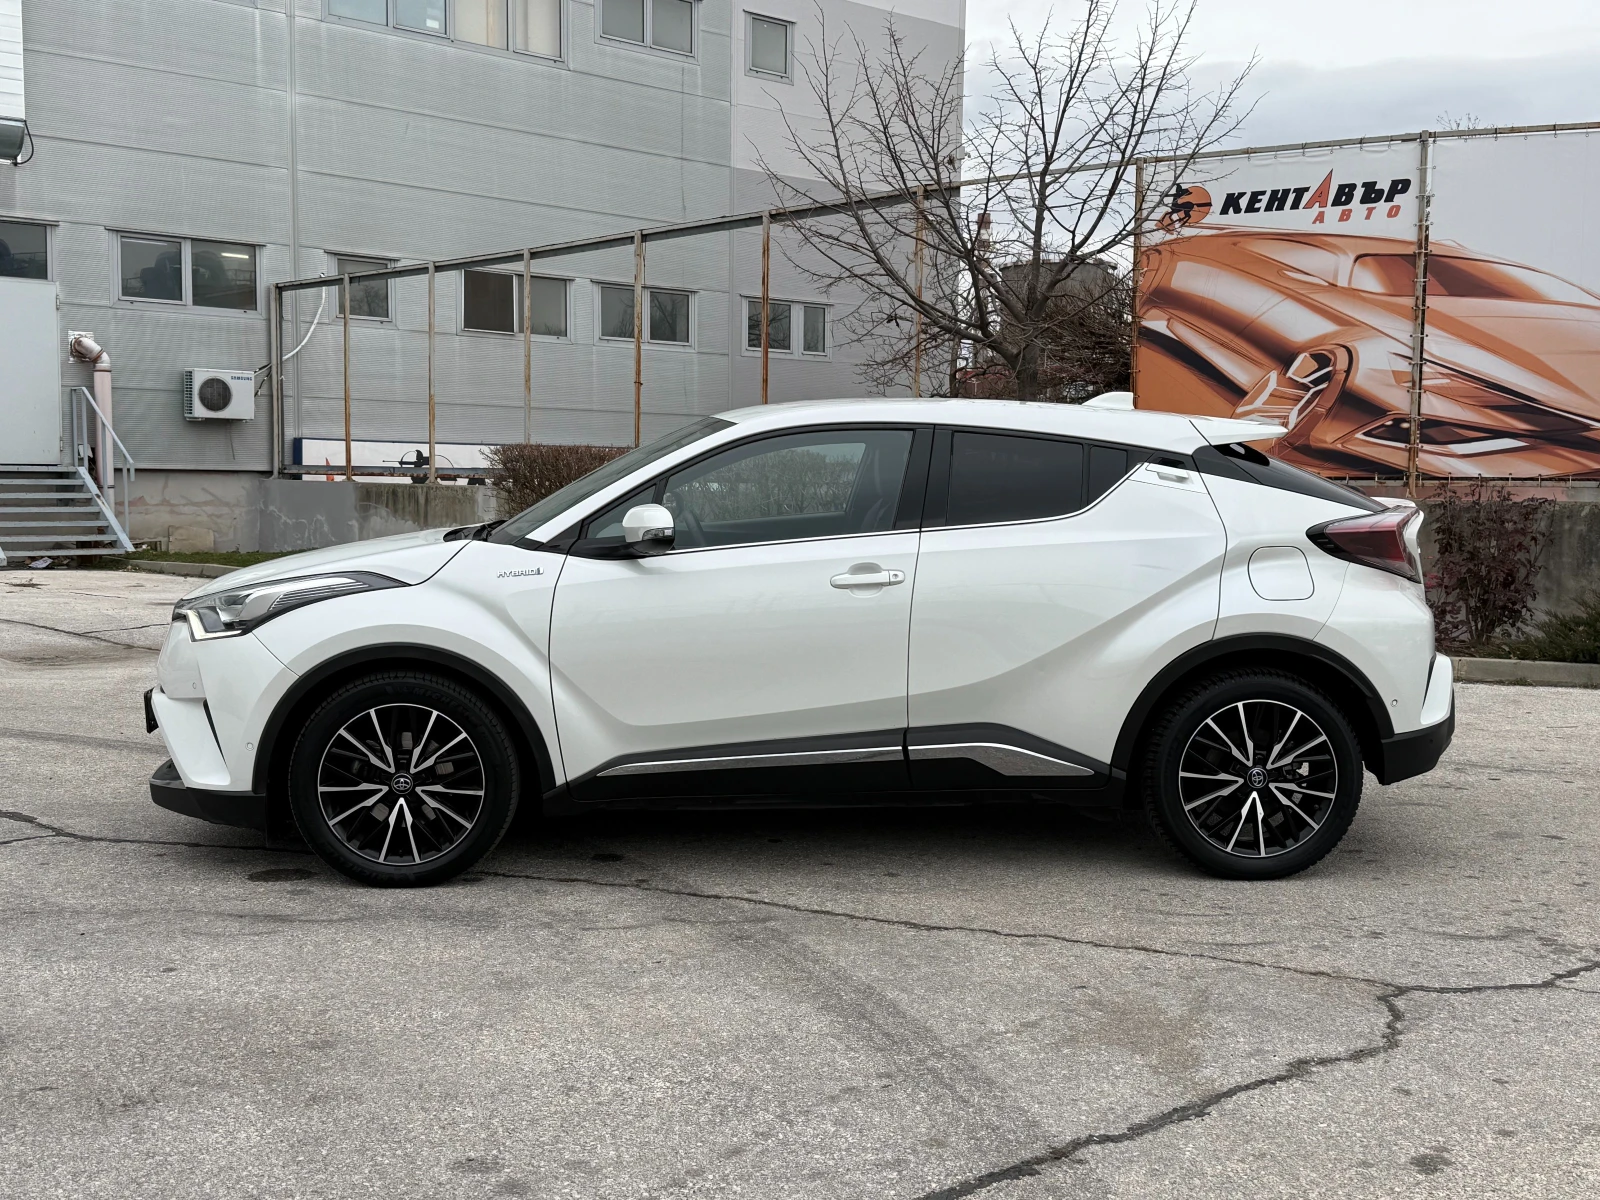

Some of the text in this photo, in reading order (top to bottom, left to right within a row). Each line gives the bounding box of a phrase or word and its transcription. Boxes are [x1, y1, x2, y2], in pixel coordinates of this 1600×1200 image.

[1219, 168, 1412, 215] КЕНТАВЪР
[1312, 204, 1401, 225] АВТО
[497, 569, 536, 578] HYBRID
